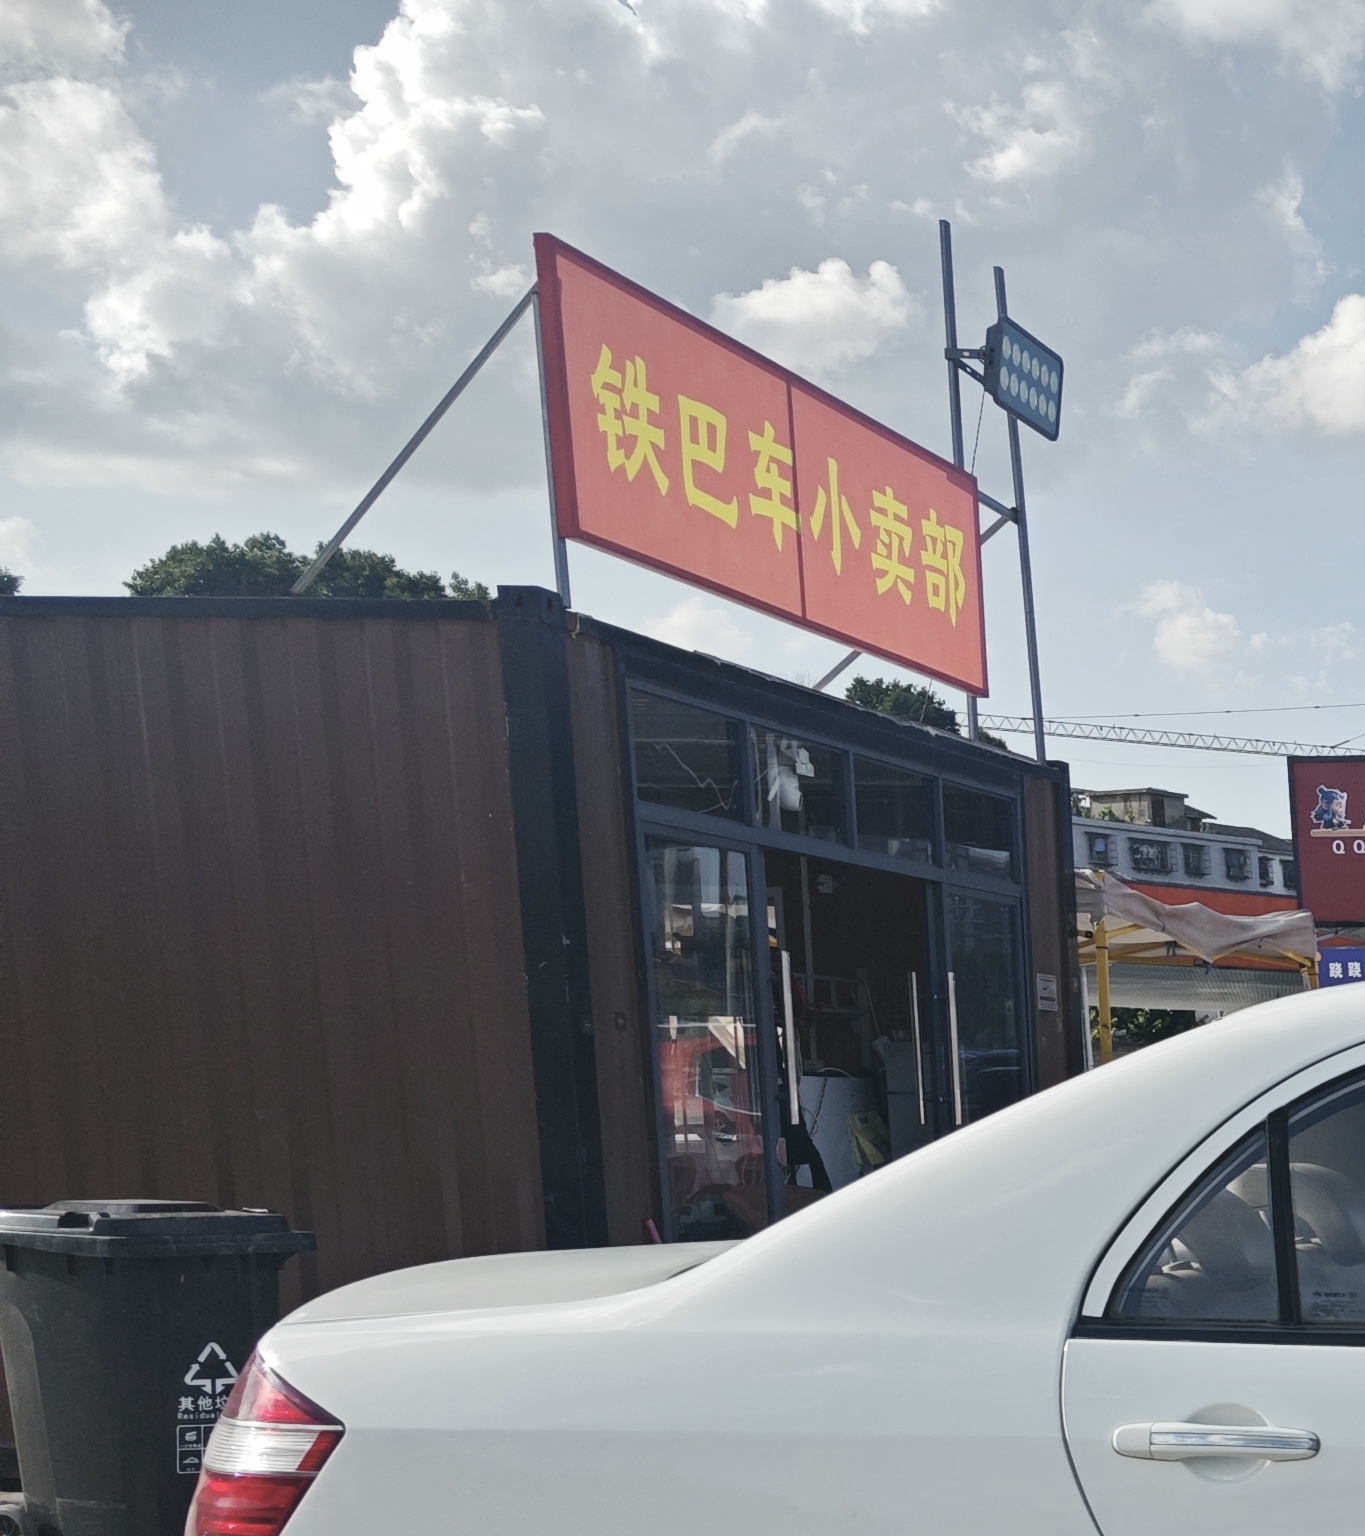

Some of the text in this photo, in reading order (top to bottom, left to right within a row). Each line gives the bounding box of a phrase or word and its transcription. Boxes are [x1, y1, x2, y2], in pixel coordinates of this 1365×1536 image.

[591, 343, 967, 629] 铁巴车小卖部
